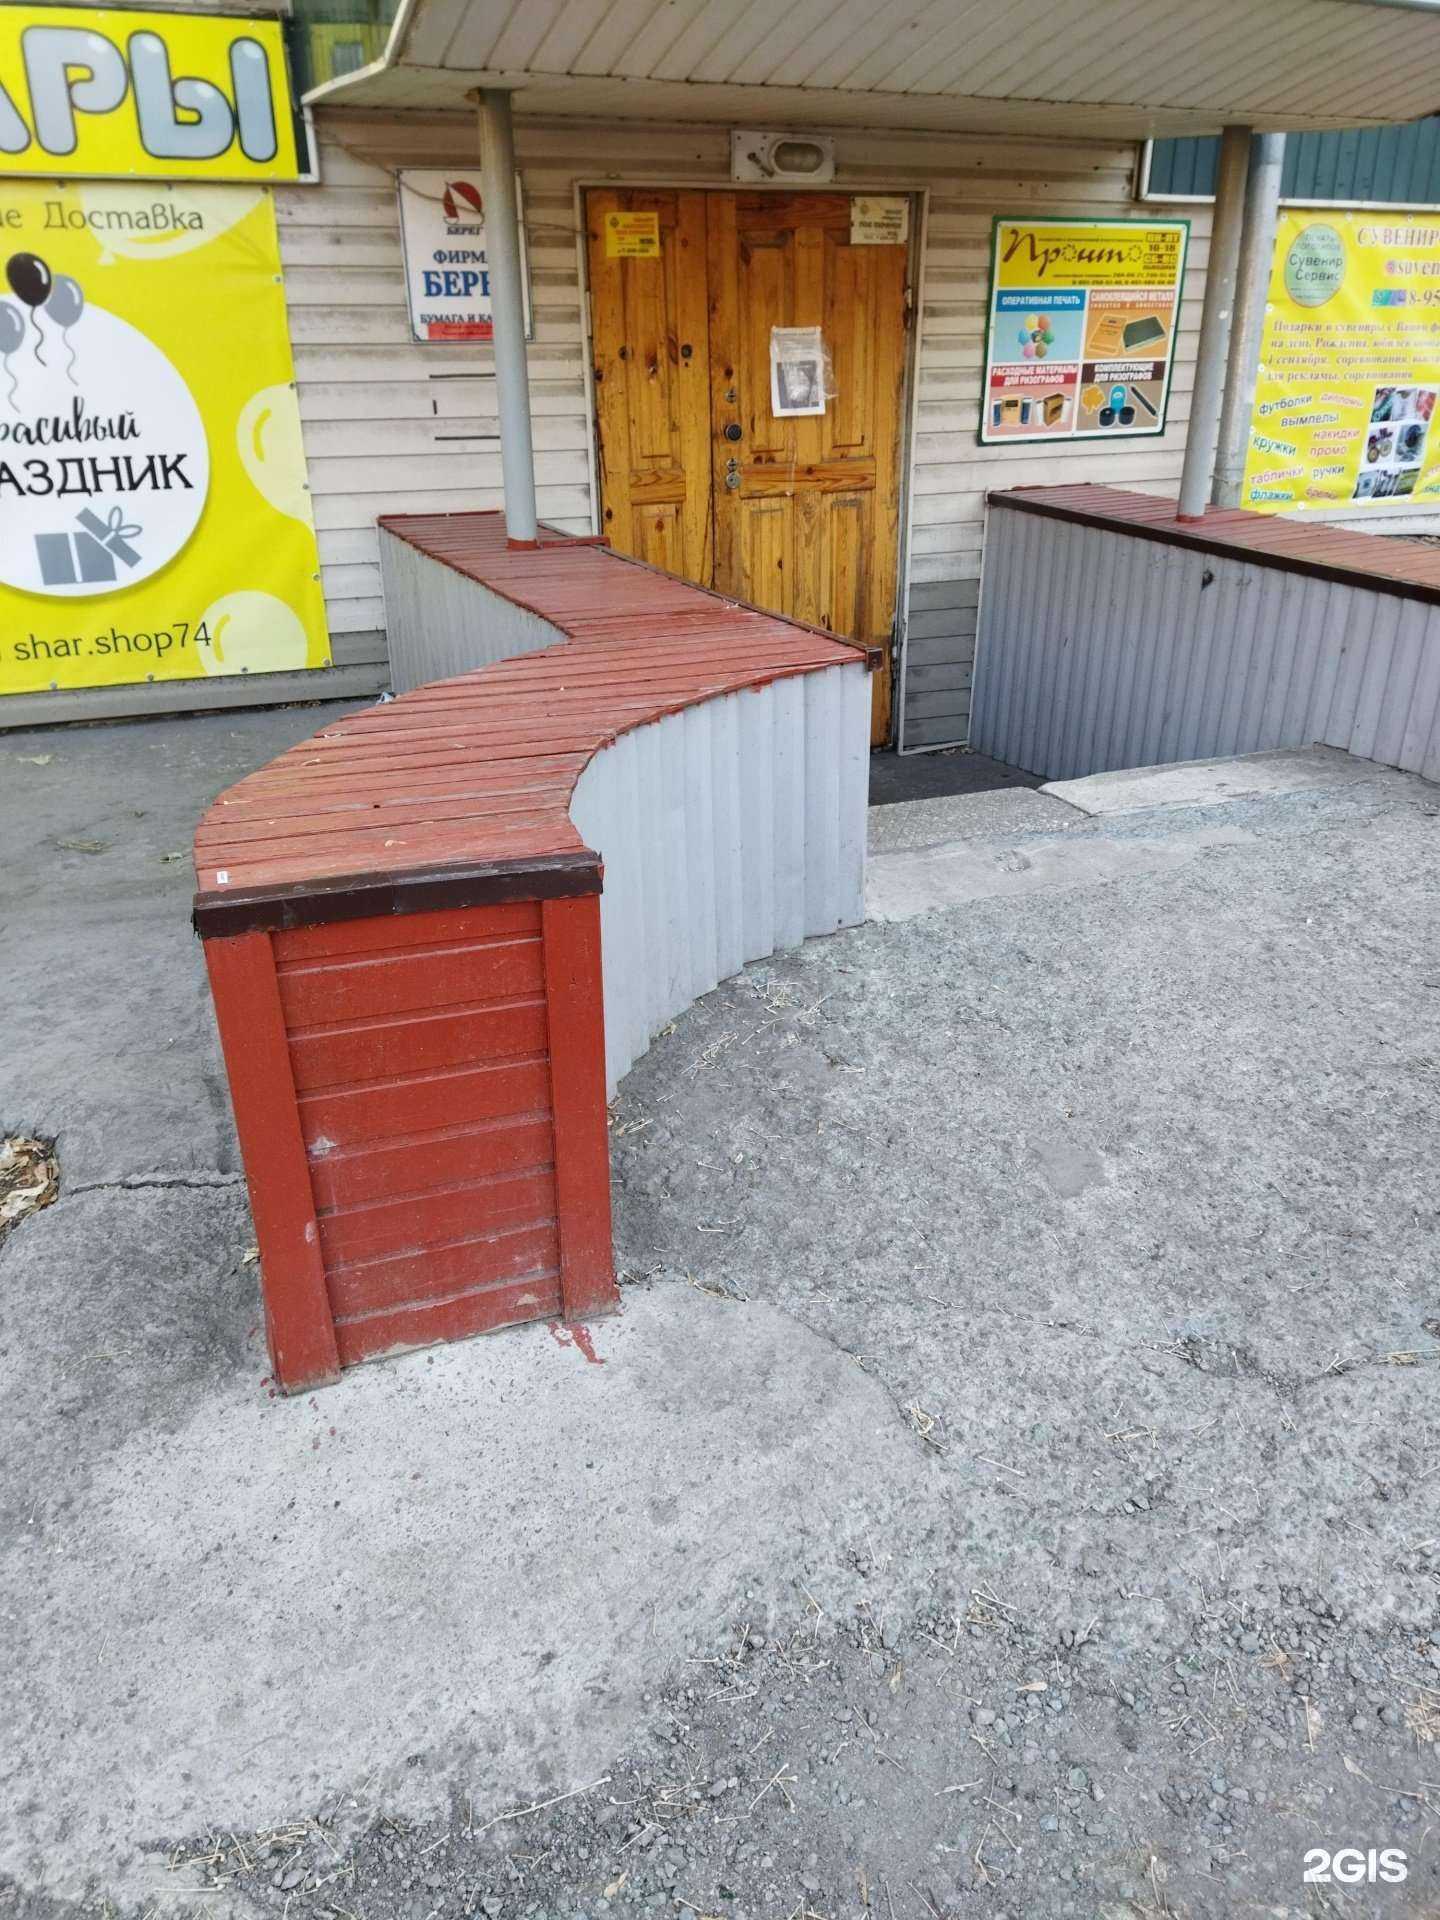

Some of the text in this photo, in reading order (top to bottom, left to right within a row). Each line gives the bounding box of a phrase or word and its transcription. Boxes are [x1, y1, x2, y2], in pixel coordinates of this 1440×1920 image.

[446, 226, 483, 236] БЕРЕГ
[1357, 228, 1440, 246] СУВЕНИР
[432, 251, 488, 264] ФИРМ
[1289, 254, 1343, 268] Сувенир
[1295, 269, 1340, 282] Сервис
[1053, 295, 1080, 305] ПЕЧАТЬ
[420, 313, 465, 324] БУМАГА
[467, 313, 475, 323] И
[1259, 394, 1312, 415] футболки
[1281, 412, 1339, 427] вымпелы
[1313, 430, 1360, 440] накидки
[1253, 435, 1297, 456] кружки
[1310, 446, 1347, 457] промо
[1251, 467, 1304, 485] таблички
[1312, 465, 1345, 480] ручки
[1250, 488, 1294, 500] флажки
[14, 621, 211, 661] shar.shop74
